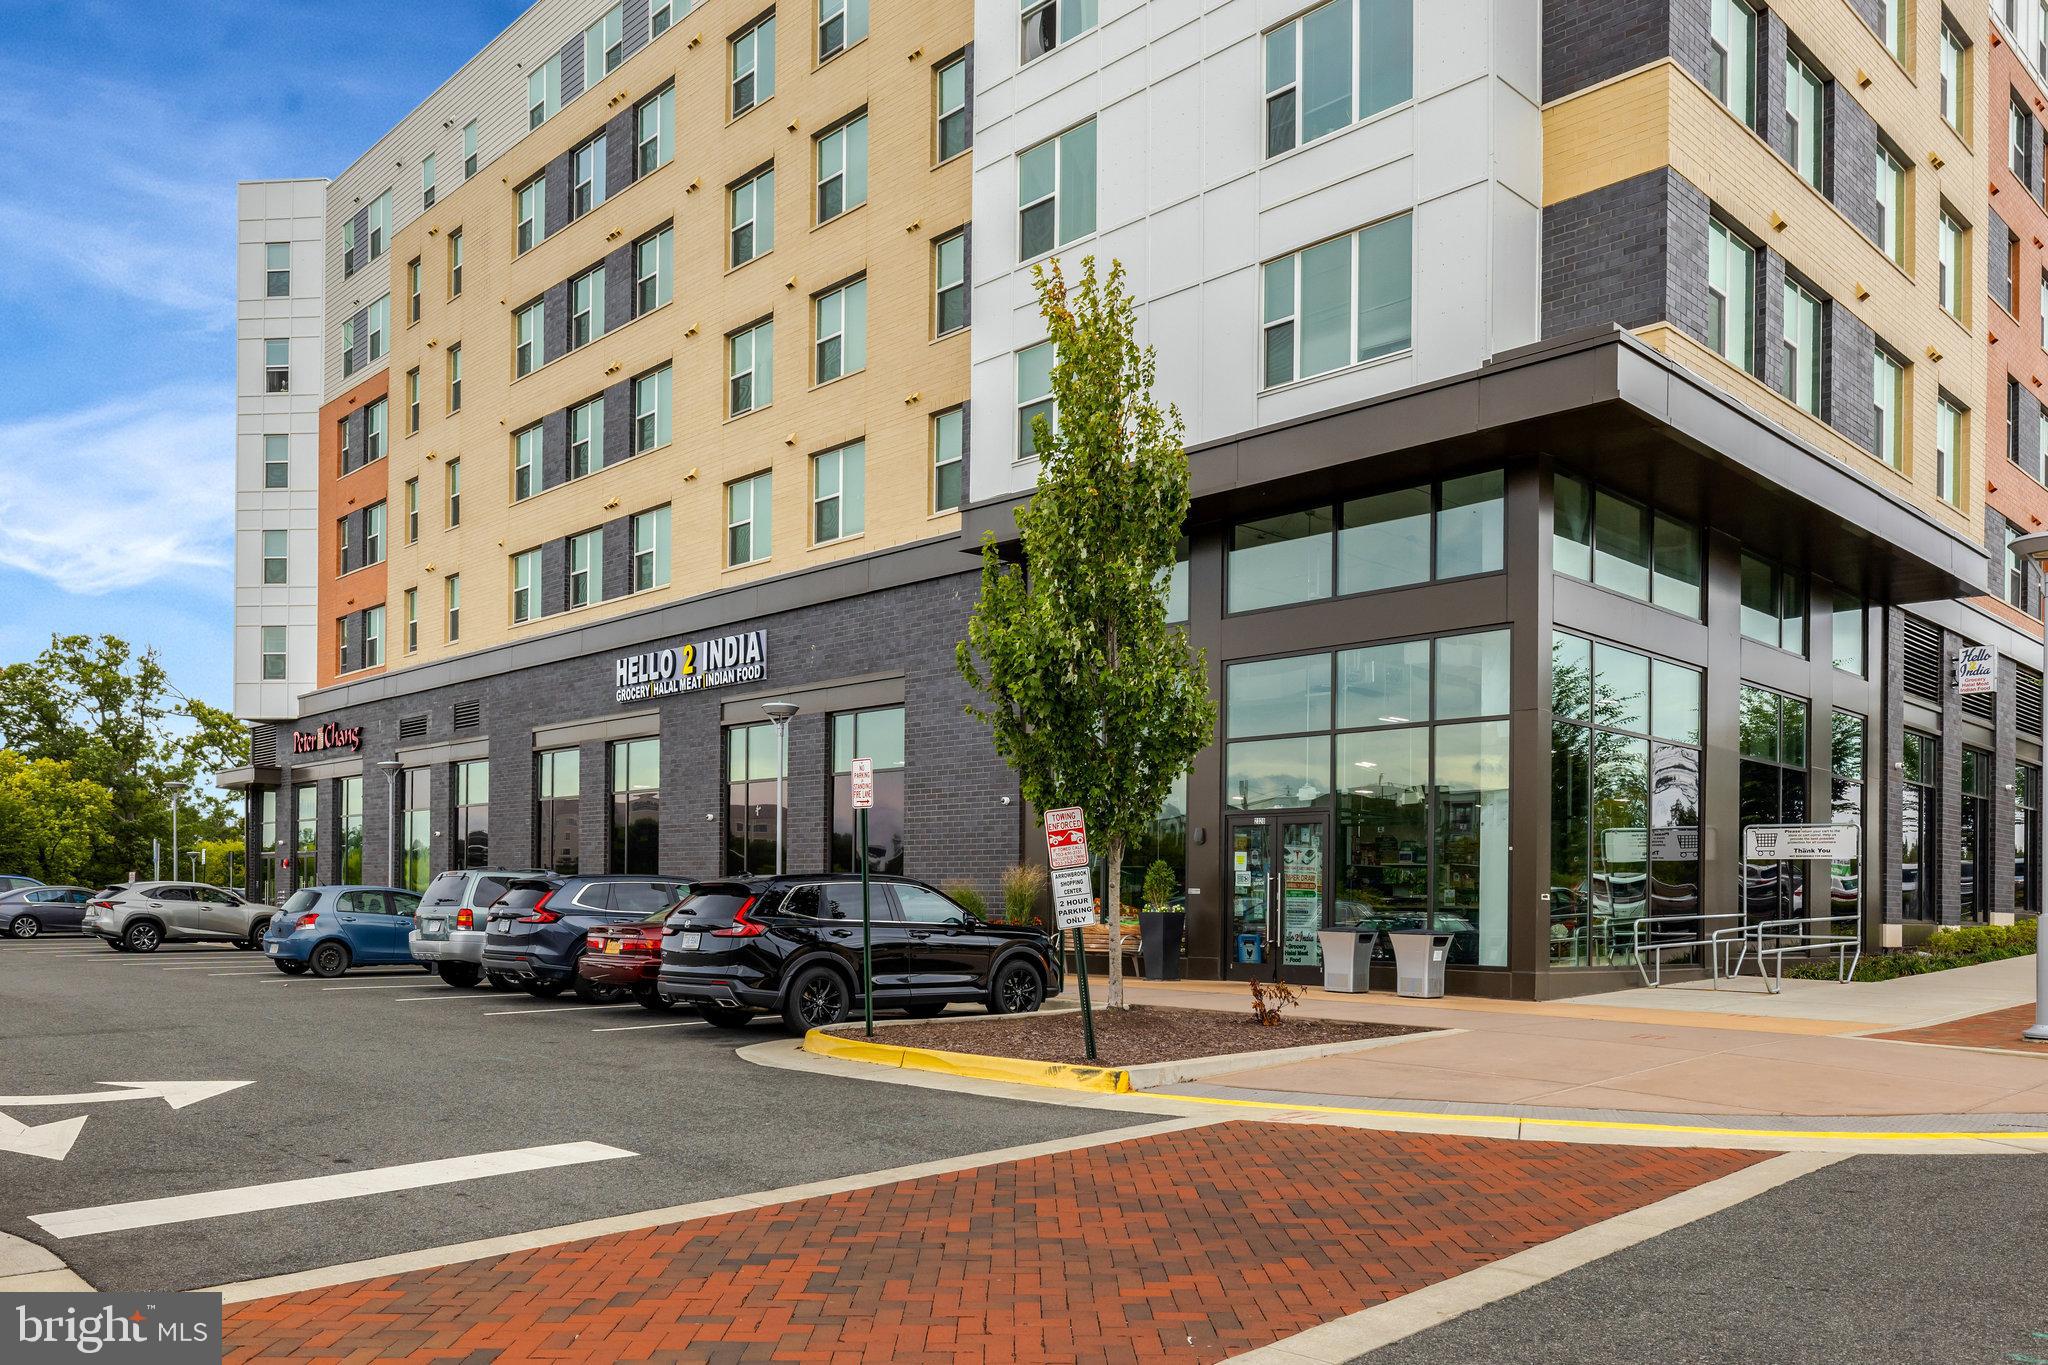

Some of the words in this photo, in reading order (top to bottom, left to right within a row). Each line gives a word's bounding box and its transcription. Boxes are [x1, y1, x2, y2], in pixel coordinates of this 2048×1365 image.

[616, 649, 675, 687] HELLO
[682, 643, 695, 676] 2
[702, 631, 762, 671] INDIA
[1961, 648, 1992, 663] Hello
[1960, 663, 1991, 677] India
[1969, 661, 1977, 671] 2
[616, 684, 651, 702] GROCERY
[653, 680, 678, 696] HALAL
[680, 676, 702, 692] MEAT
[705, 670, 735, 687] INDIAN
[736, 664, 761, 681] FOOD
[293, 731, 316, 753] Peter
[325, 722, 360, 752] Chang
[1052, 812, 1076, 822] TOWING
[1049, 820, 1082, 830] ENFORCED
[1055, 870, 1087, 879] ARROWBROOK
[1060, 879, 1083, 887] SHOPPING
[1066, 897, 1088, 906] HOUR
[1058, 906, 1092, 916] PARKING
[1066, 916, 1086, 924] ONLY
